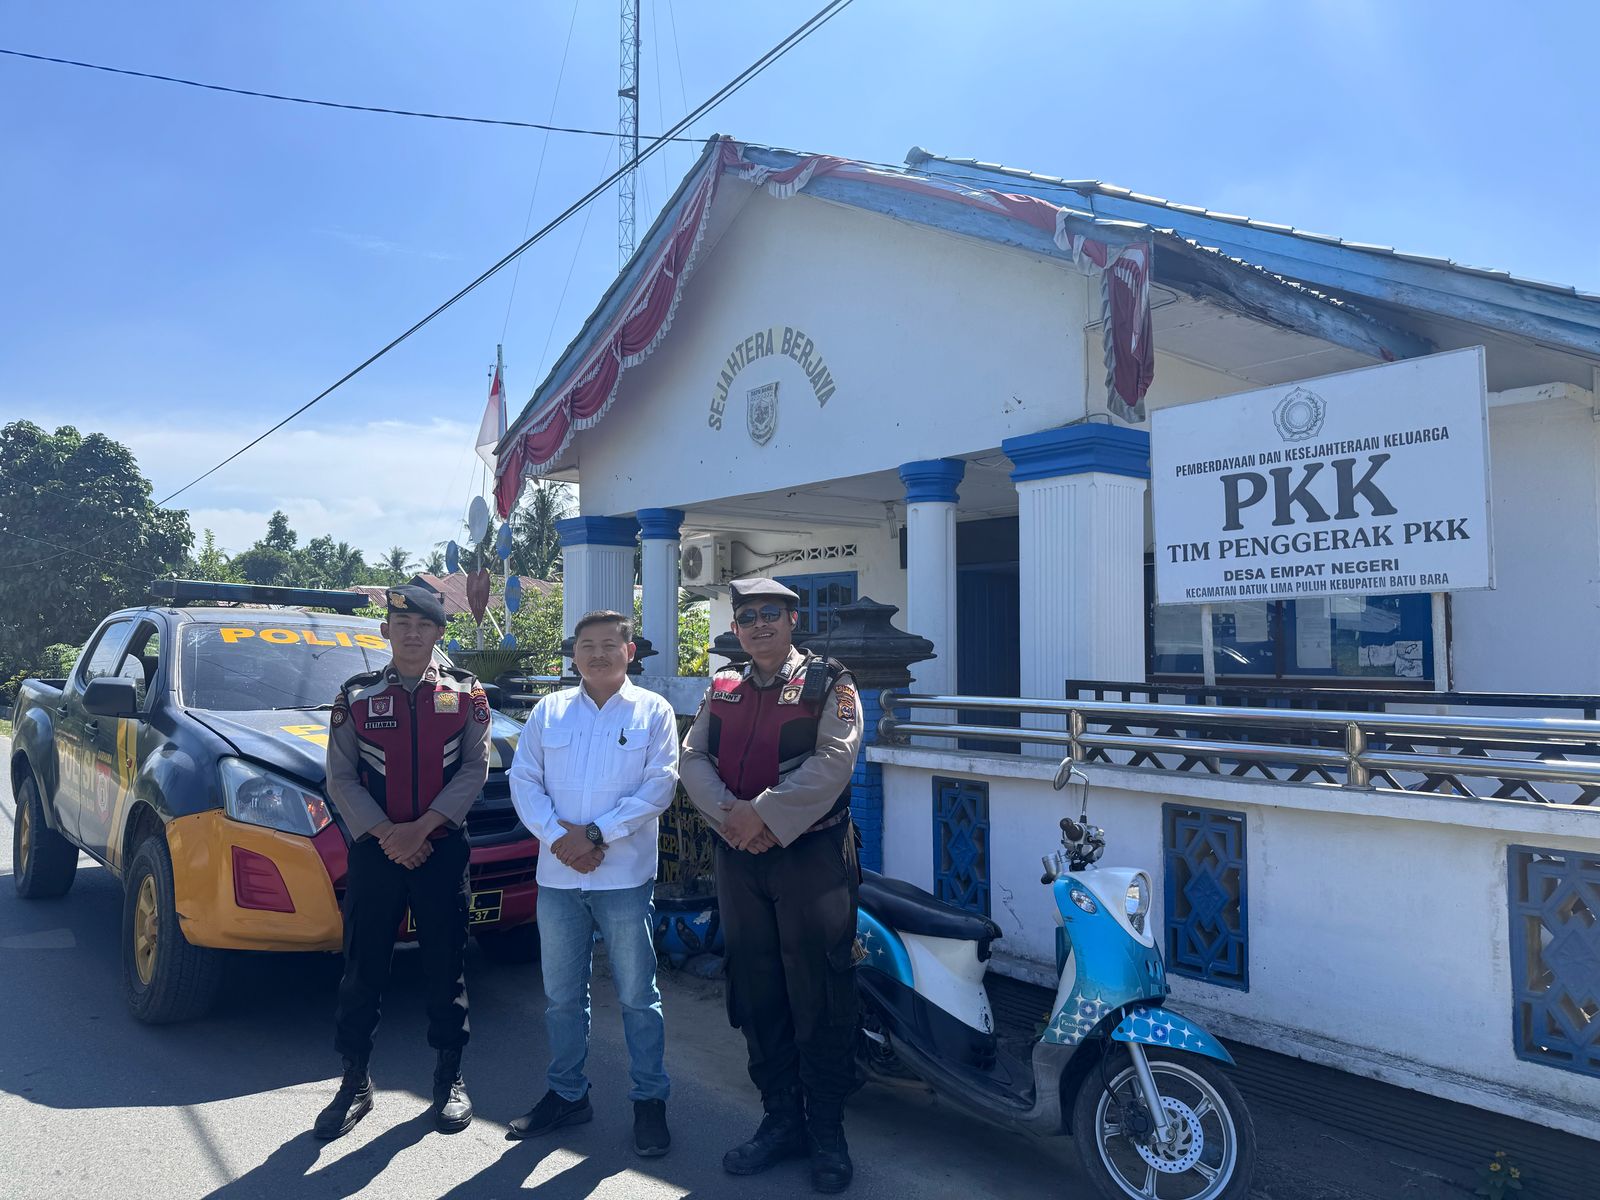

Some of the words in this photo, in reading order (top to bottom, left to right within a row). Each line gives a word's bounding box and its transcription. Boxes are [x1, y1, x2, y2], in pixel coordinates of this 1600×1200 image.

[708, 328, 774, 431] SEJAHTERA
[780, 326, 836, 409] BERJAYA
[1176, 456, 1256, 478] PEMBERDAYAAN
[1259, 452, 1282, 466] DAN
[1284, 438, 1380, 463] KESEJAHTERAAN
[1384, 426, 1449, 448] KELUARGA
[1219, 453, 1398, 531] PKK
[1167, 541, 1210, 563] TIM
[1218, 524, 1394, 559] PENGGERAK
[1403, 517, 1470, 545] PKK
[1185, 585, 1237, 598] KECAMATAN
[1239, 583, 1269, 596] DATUK
[1270, 581, 1294, 594] LIMA
[1295, 579, 1327, 592] PULUH
[1329, 576, 1386, 591] KEBUPATEN
[1389, 575, 1416, 588] BATU
[1419, 573, 1449, 586] BARA
[1223, 566, 1266, 582] DESA
[1270, 563, 1325, 578] EMPAT
[1331, 558, 1399, 575] NEGERI
